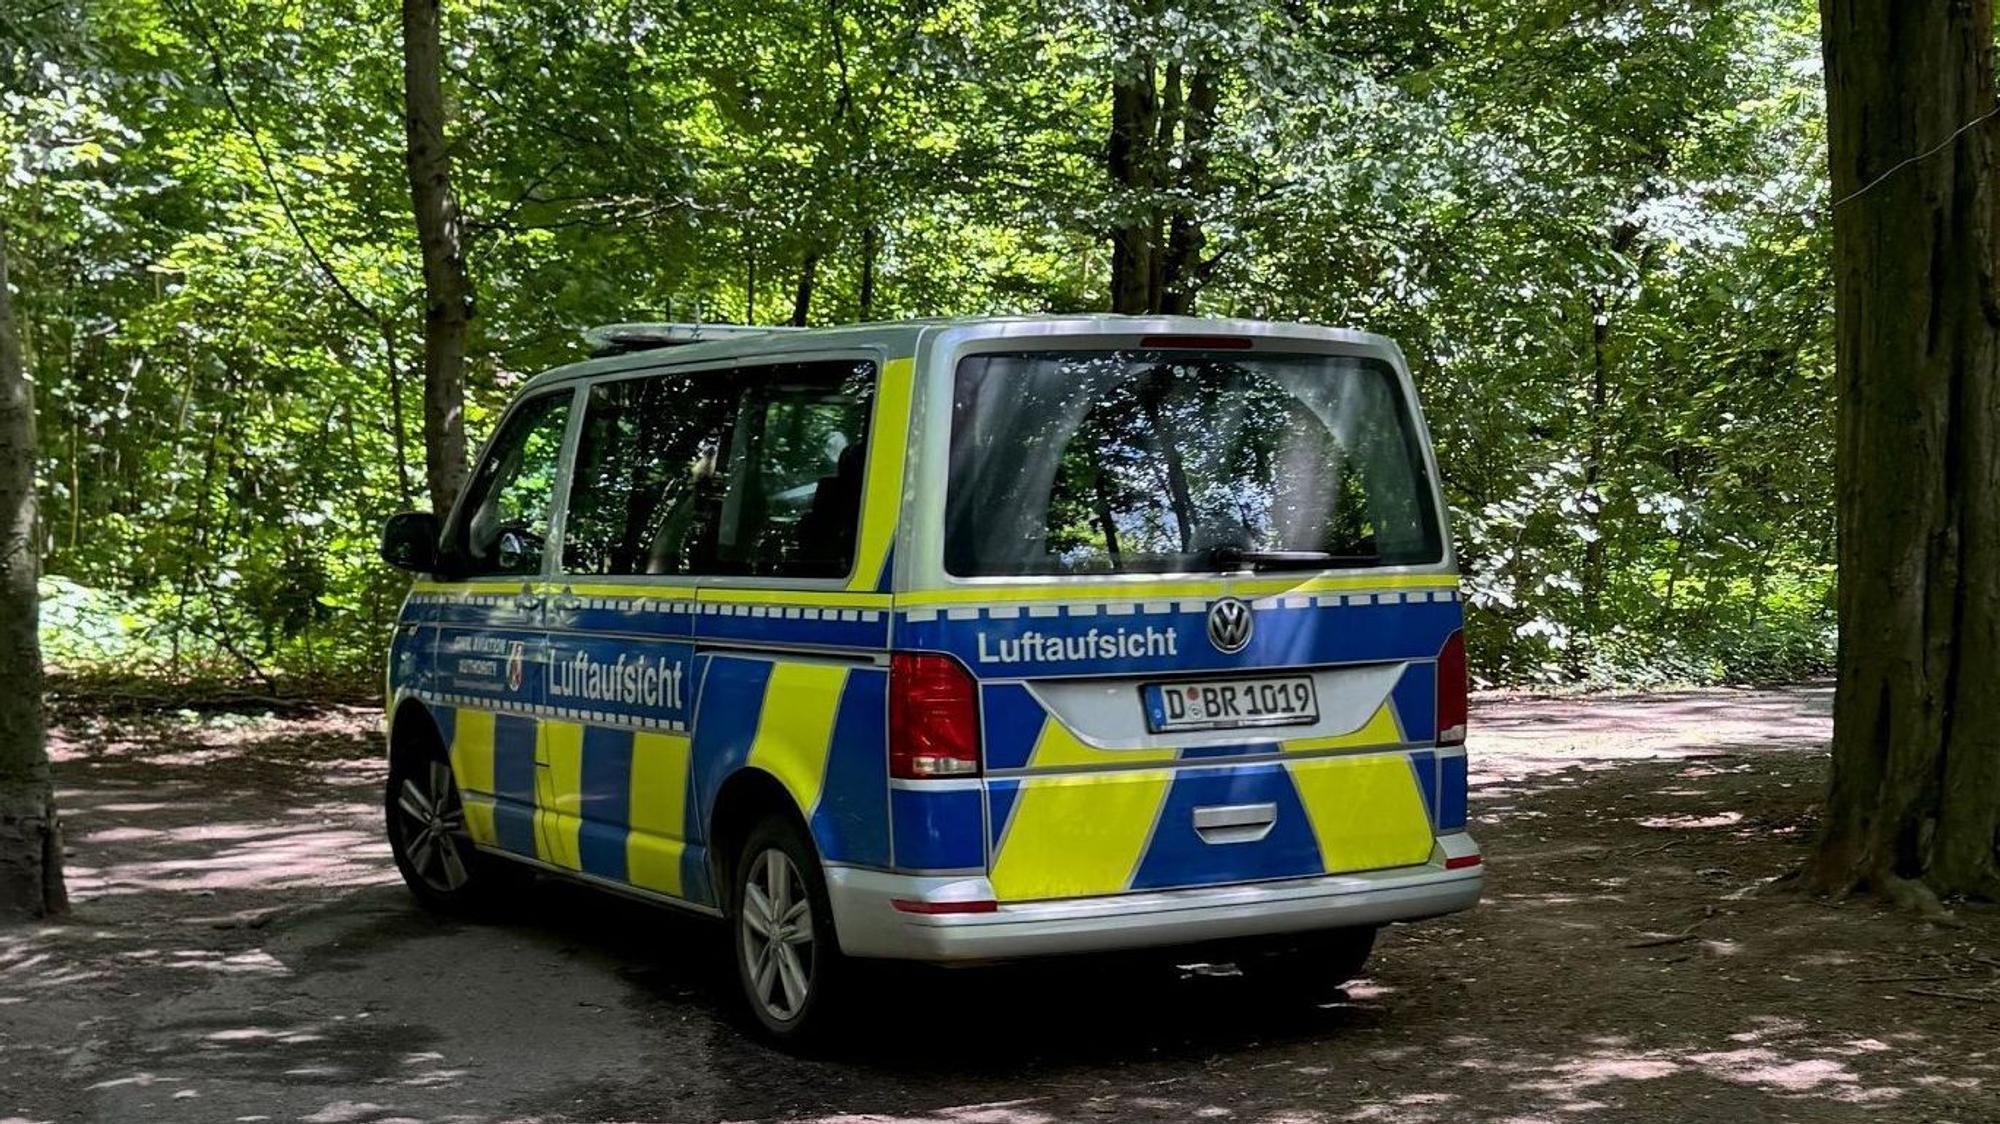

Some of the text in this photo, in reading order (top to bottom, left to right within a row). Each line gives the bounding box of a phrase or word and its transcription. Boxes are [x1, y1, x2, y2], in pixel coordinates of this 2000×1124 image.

[978, 626, 1177, 663] Luftaufsicht
[1210, 599, 1251, 652] VW
[549, 649, 682, 710] Luftaufsicht
[1165, 683, 1309, 720] D BR 1019
